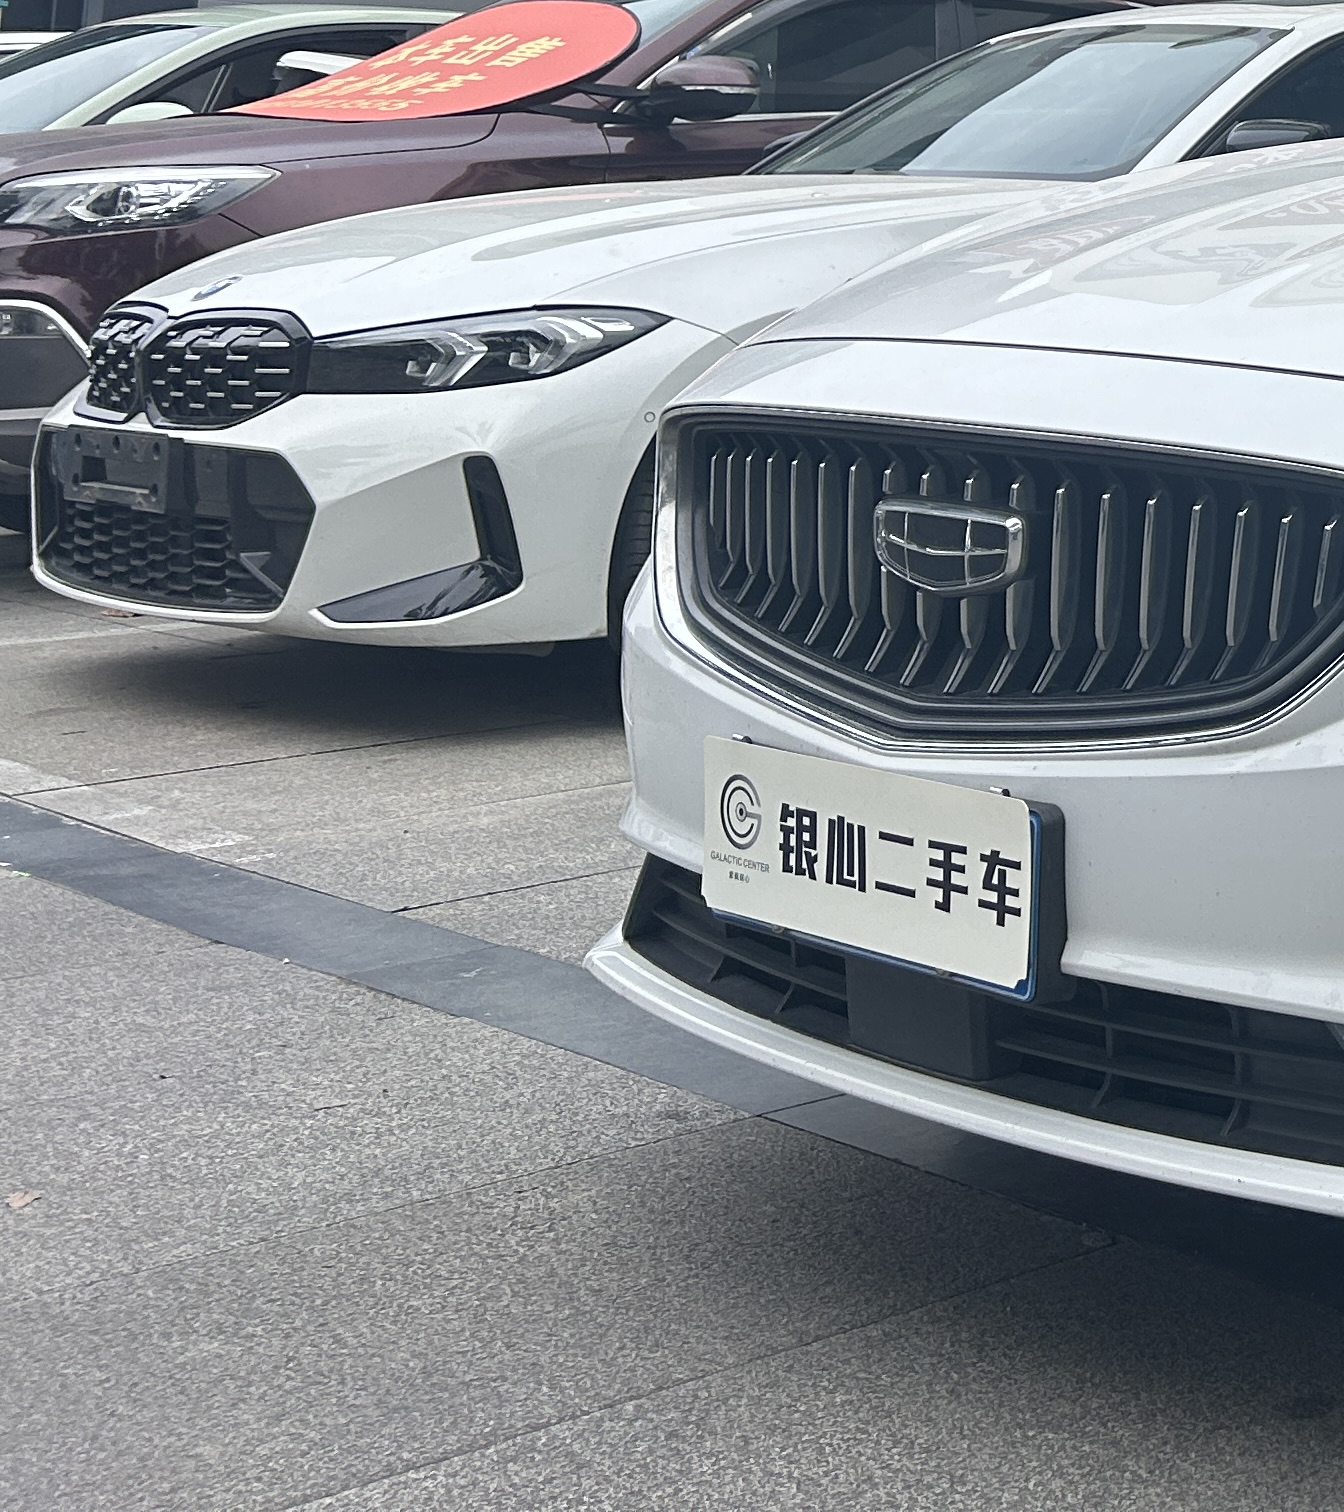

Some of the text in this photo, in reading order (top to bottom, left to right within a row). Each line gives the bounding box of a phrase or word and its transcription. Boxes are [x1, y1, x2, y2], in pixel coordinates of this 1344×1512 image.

[710, 849, 770, 874] GALACTIC CENTER
[778, 802, 1023, 928] 银心二手车
